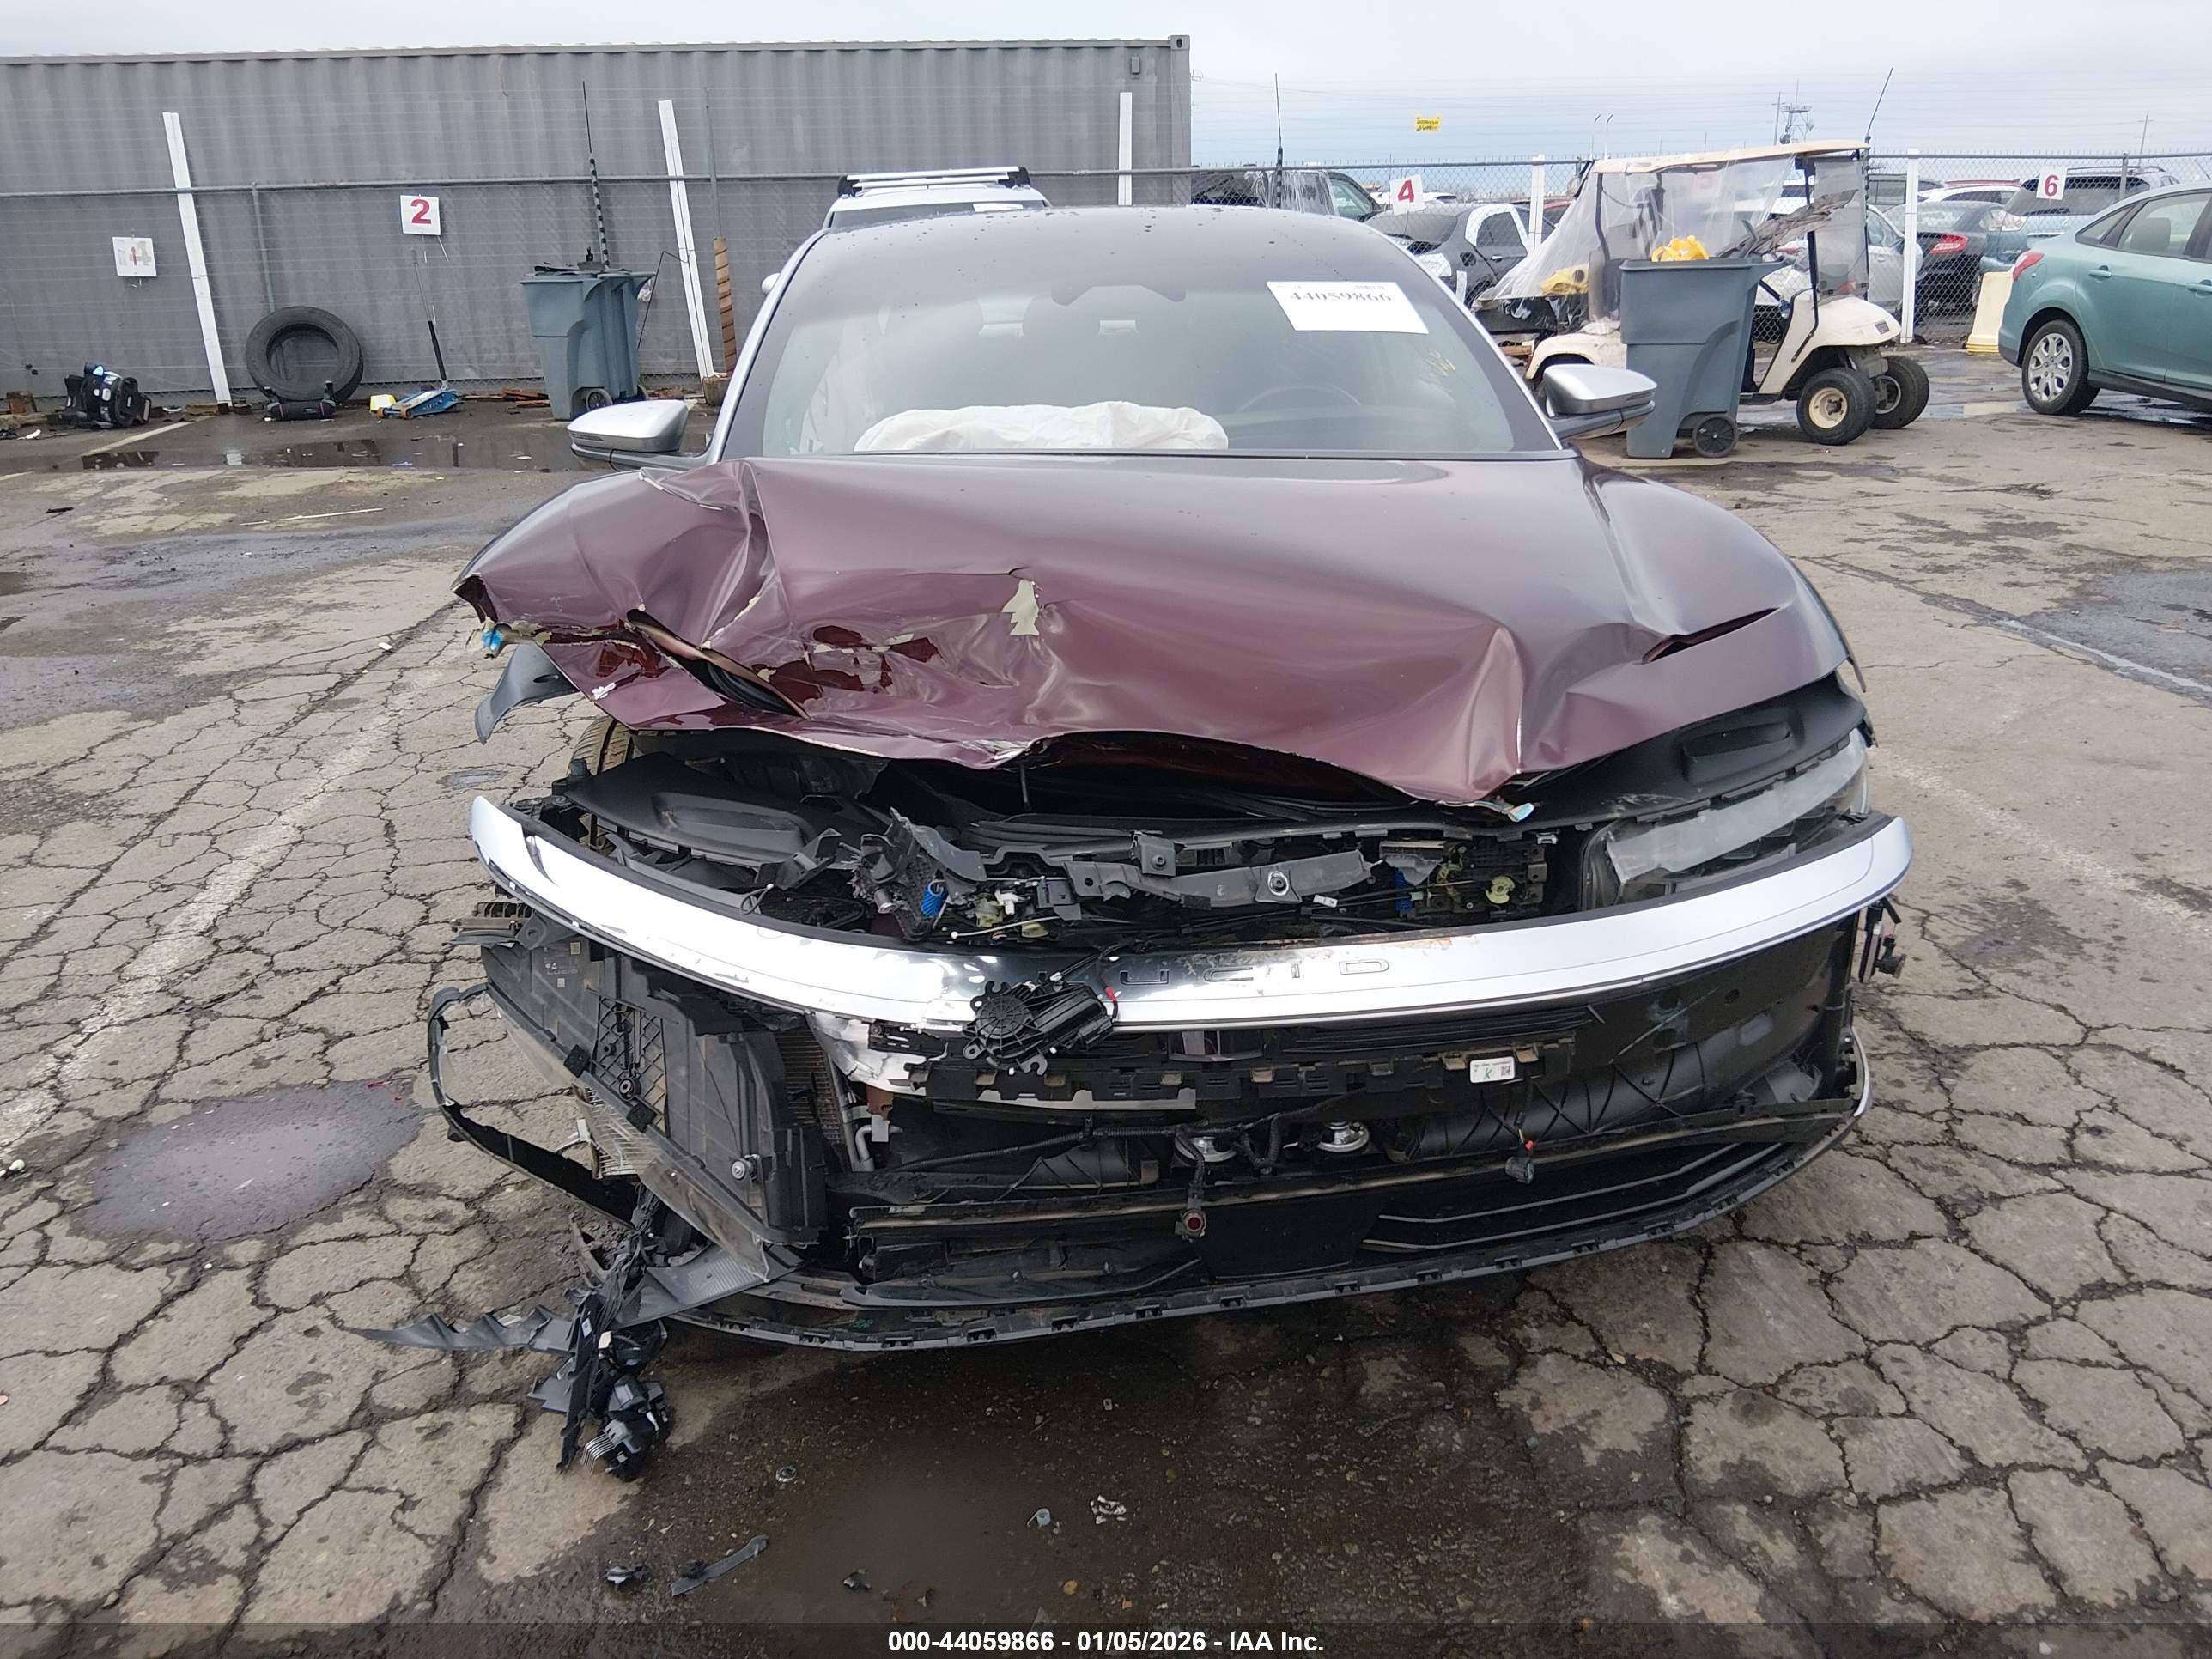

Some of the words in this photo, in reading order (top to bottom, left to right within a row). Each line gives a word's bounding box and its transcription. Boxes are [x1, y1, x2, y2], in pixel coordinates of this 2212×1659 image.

[1397, 179, 1414, 203] 4
[2044, 174, 2059, 197] 6
[410, 199, 431, 224] 2
[1289, 291, 1392, 301] 44059866
